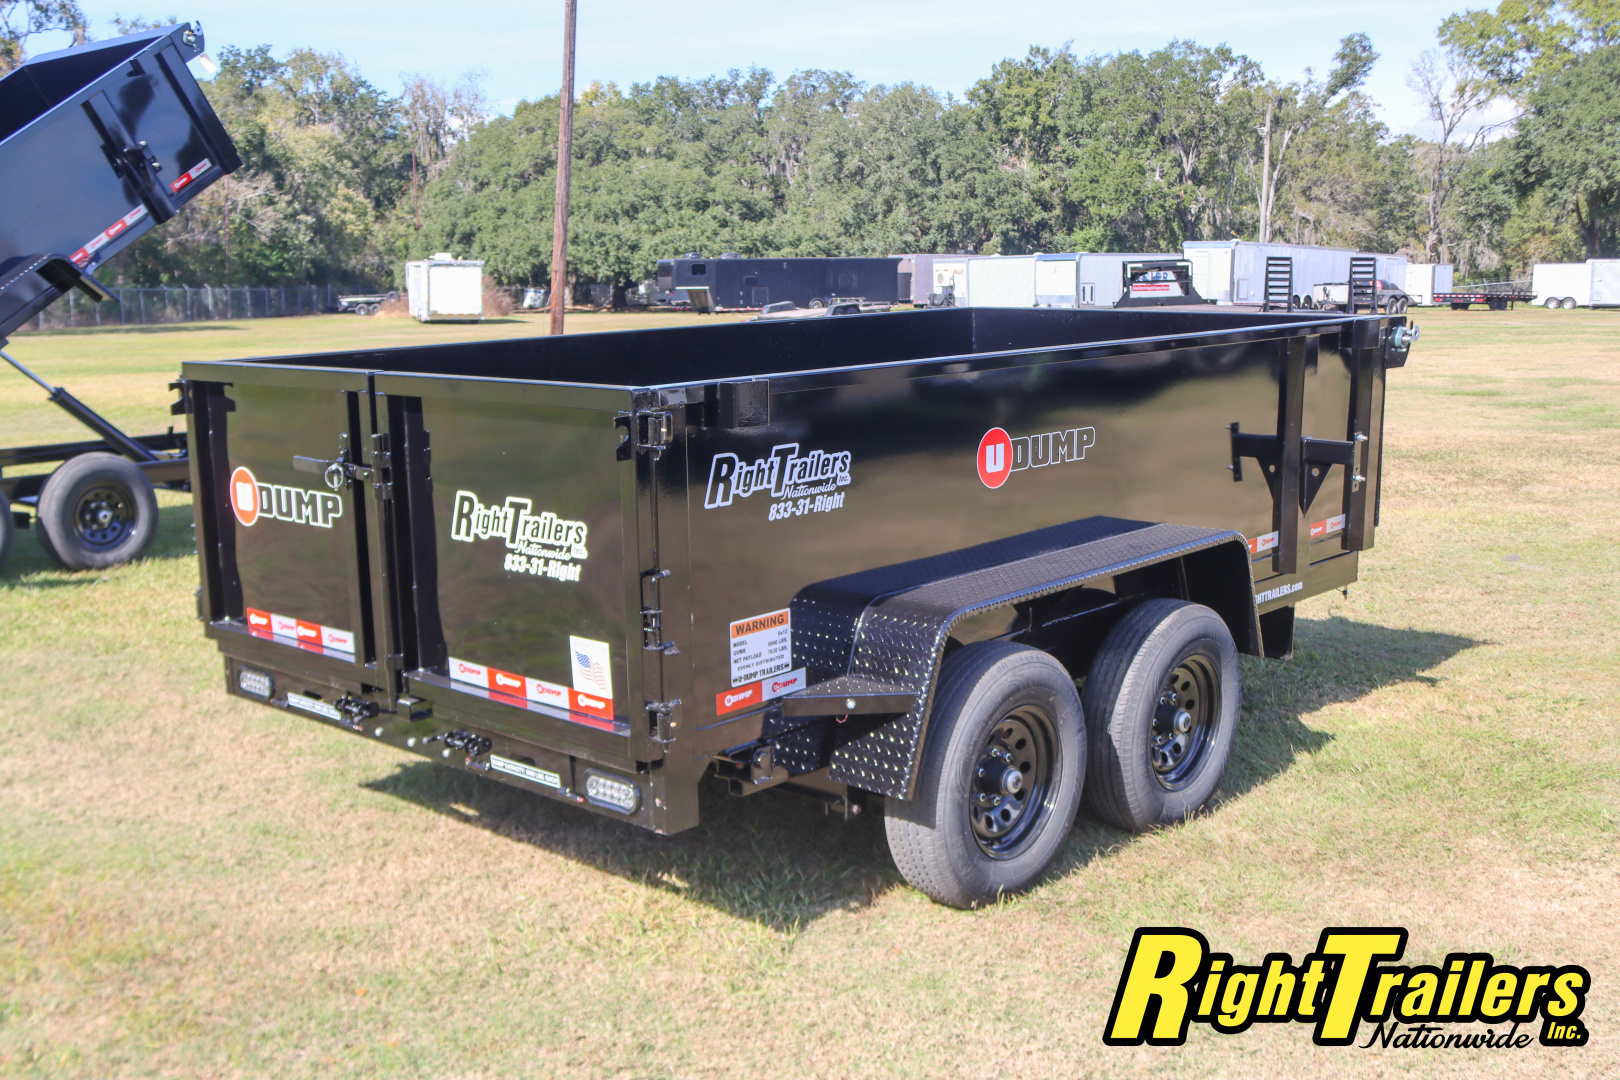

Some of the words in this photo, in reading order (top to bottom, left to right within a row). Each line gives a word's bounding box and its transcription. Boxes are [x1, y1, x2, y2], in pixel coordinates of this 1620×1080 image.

[780, 478, 837, 500] Nationwide
[768, 492, 845, 521] 833-31-Right
[514, 540, 571, 560] Nationwide
[504, 553, 581, 581] 833-31-Right
[735, 614, 785, 636] WARNING
[733, 640, 748, 648] MODEL
[733, 657, 742, 665] NET
[743, 652, 762, 662] PAYLOAD
[737, 663, 754, 672] EVENLY
[755, 654, 785, 667] DISTRIBUTED
[759, 663, 784, 677] TRAILERS
